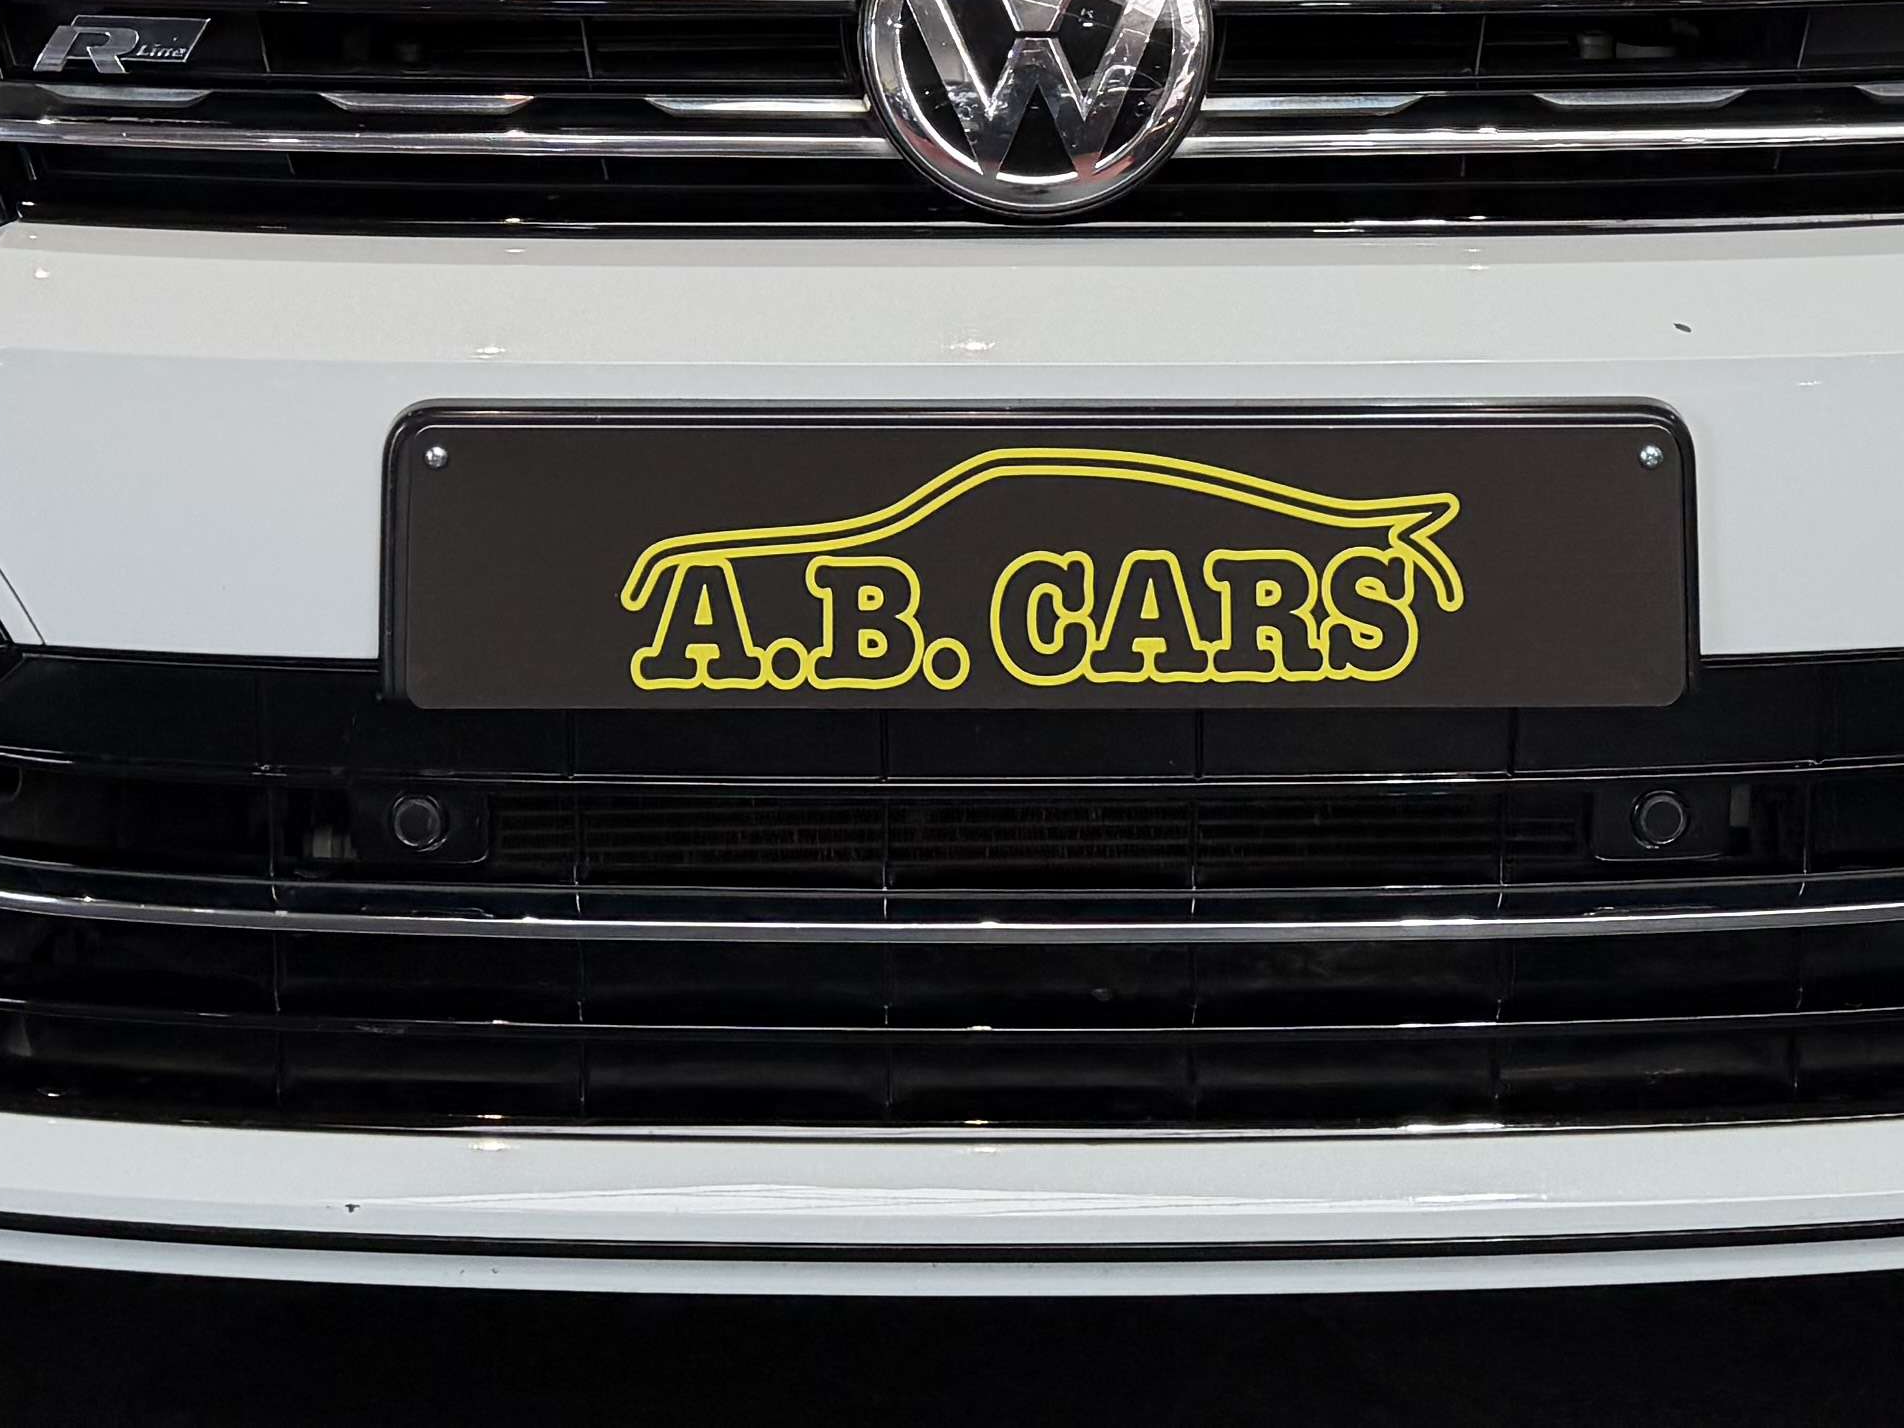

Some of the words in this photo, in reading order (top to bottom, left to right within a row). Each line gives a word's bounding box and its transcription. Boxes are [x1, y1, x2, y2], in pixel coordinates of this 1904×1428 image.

[33, 25, 130, 74] R
[135, 43, 187, 58] Line
[630, 555, 970, 690] A.B.
[990, 546, 1419, 686] CARS
